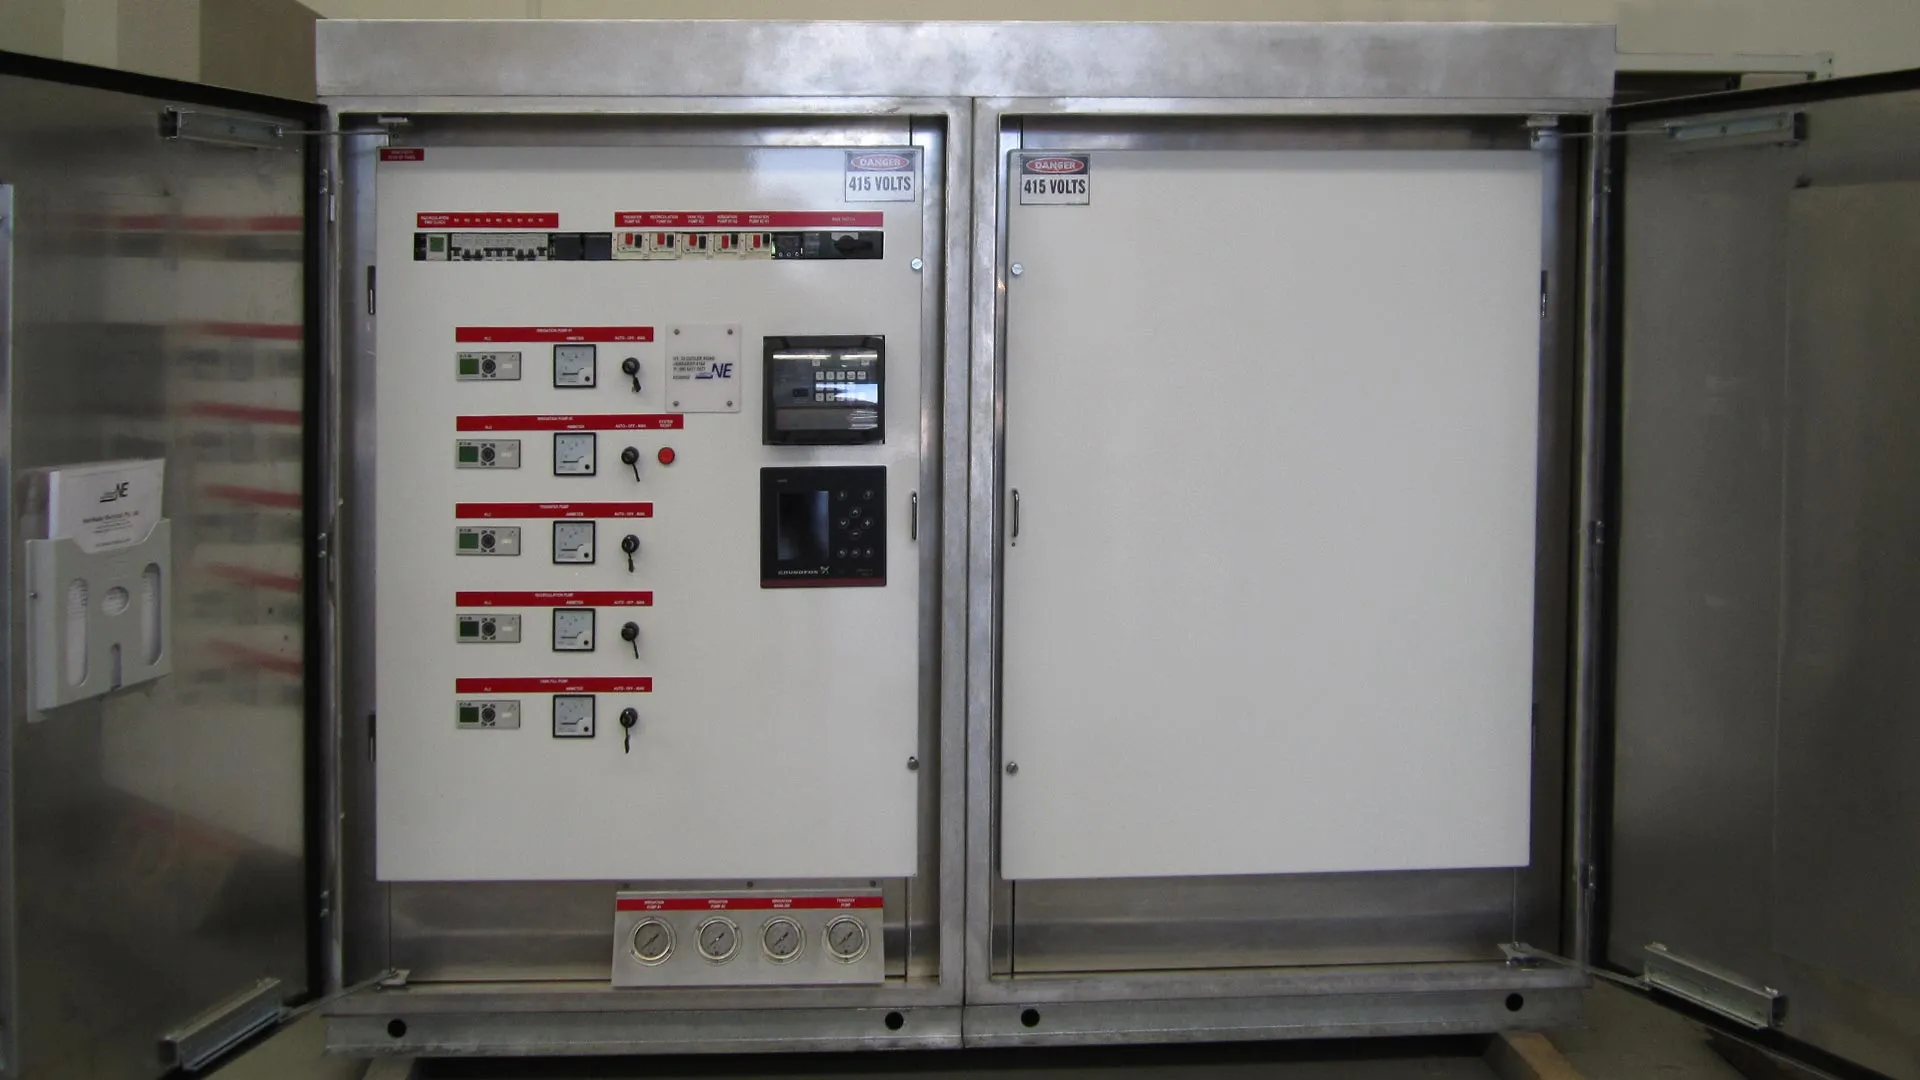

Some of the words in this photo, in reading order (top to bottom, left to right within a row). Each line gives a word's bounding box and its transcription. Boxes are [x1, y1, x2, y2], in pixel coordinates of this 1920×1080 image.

[860, 157, 901, 166] DANGER
[1035, 161, 1076, 170] DANGER
[849, 176, 871, 191] 415
[875, 176, 911, 191] VOLTS
[1024, 179, 1046, 194] 415
[1050, 179, 1086, 194] VOLTS
[711, 363, 733, 378] NE
